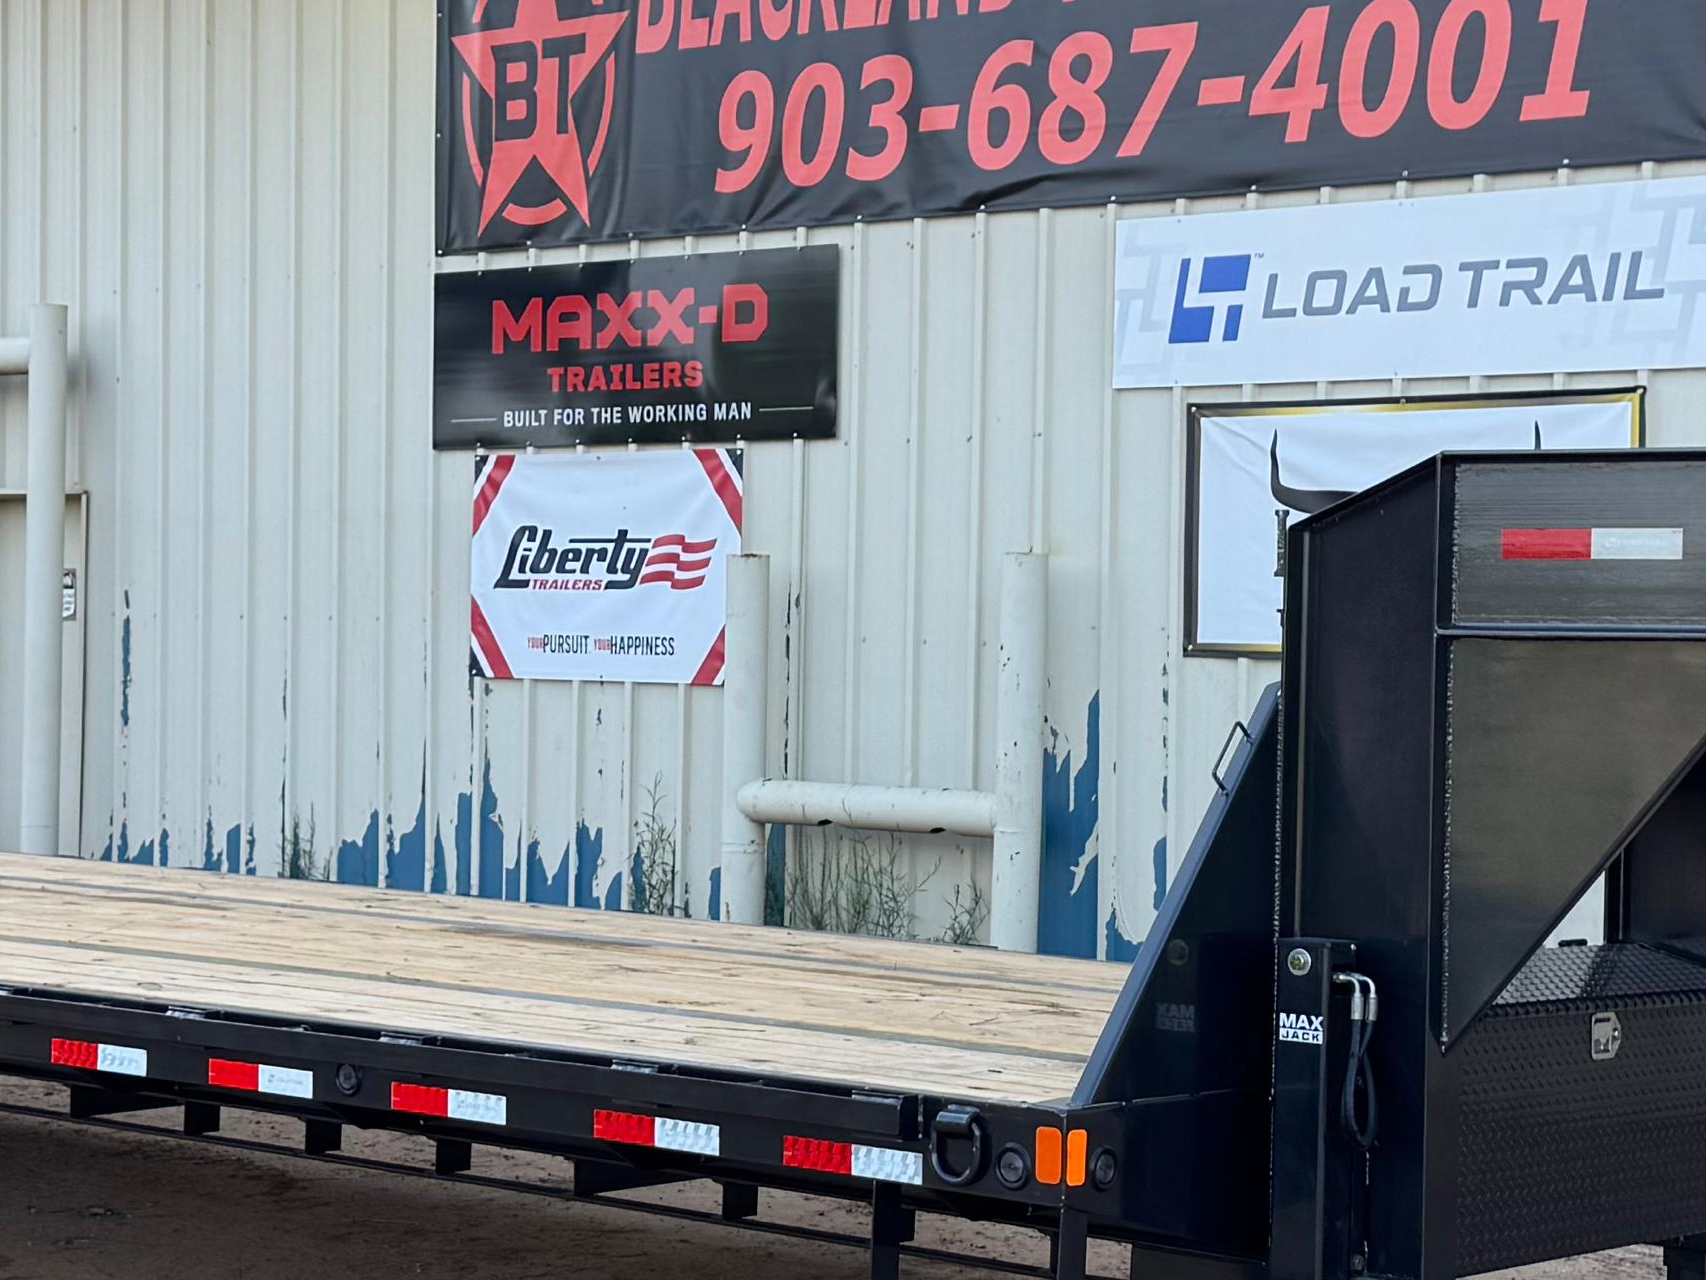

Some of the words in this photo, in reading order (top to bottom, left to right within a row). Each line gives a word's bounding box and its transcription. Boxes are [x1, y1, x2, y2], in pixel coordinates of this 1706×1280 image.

[490, 34, 587, 143] BT
[1262, 264, 1443, 319] LOAD
[1458, 251, 1665, 308] TRAIL
[492, 283, 768, 354] MAXX-D
[547, 361, 703, 393] TRAILERS
[503, 409, 546, 427] BUILT
[554, 407, 584, 425] FOR
[591, 406, 621, 424] THE
[628, 403, 706, 423] WORKING
[714, 402, 752, 420] MAN
[493, 525, 652, 590] Liberty
[531, 579, 604, 591] TRAILERS
[1279, 1012, 1323, 1031] MAX
[1281, 1030, 1320, 1042] JACK
